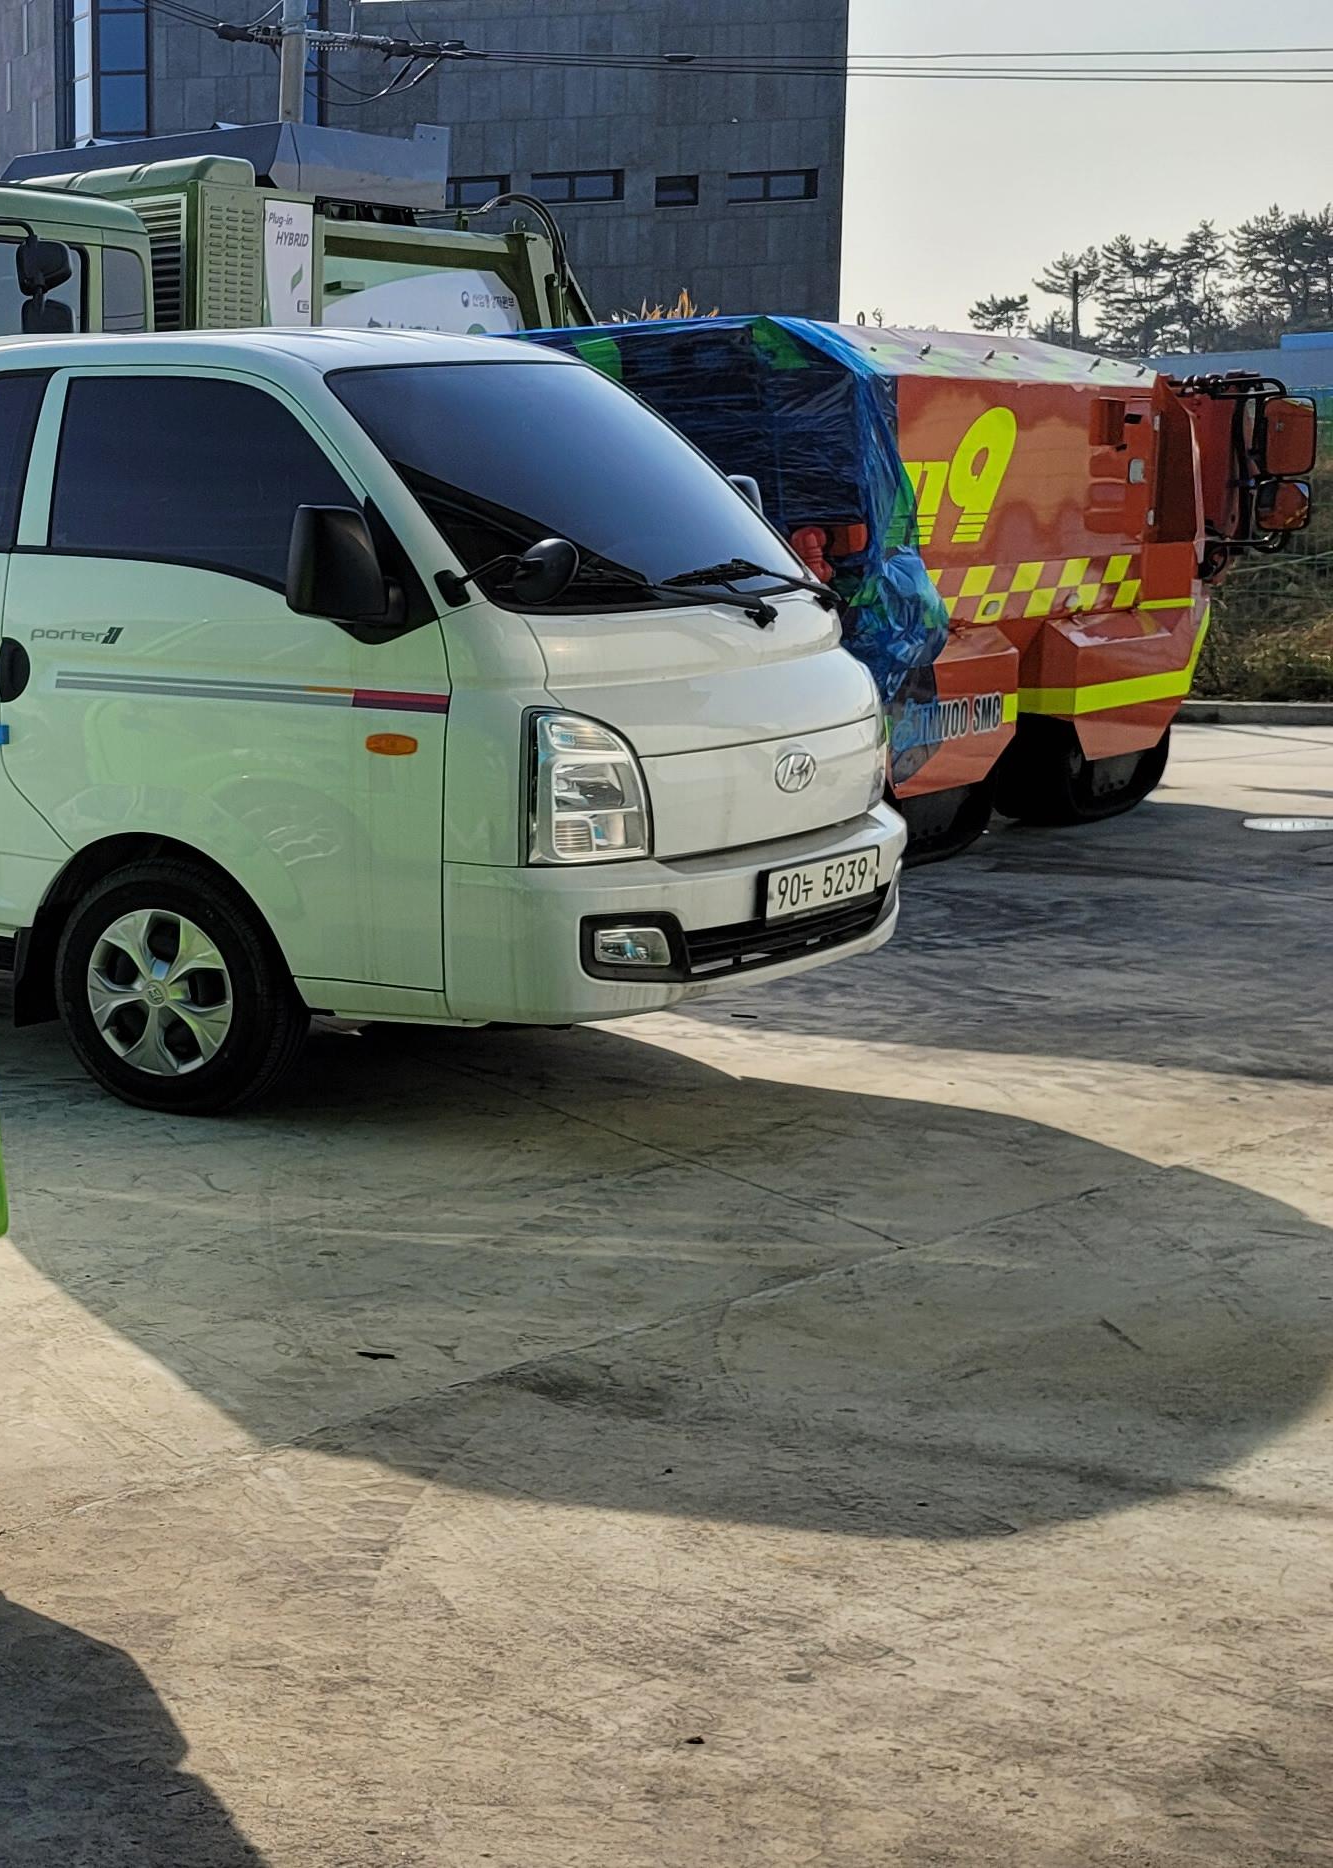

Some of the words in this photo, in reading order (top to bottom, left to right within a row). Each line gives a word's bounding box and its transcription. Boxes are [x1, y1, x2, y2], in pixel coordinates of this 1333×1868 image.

[268, 212, 293, 228] Plug-in
[275, 231, 309, 248] HYBRID
[972, 690, 1002, 735] SMC
[778, 873, 814, 910] 90누
[822, 857, 868, 899] 5239
